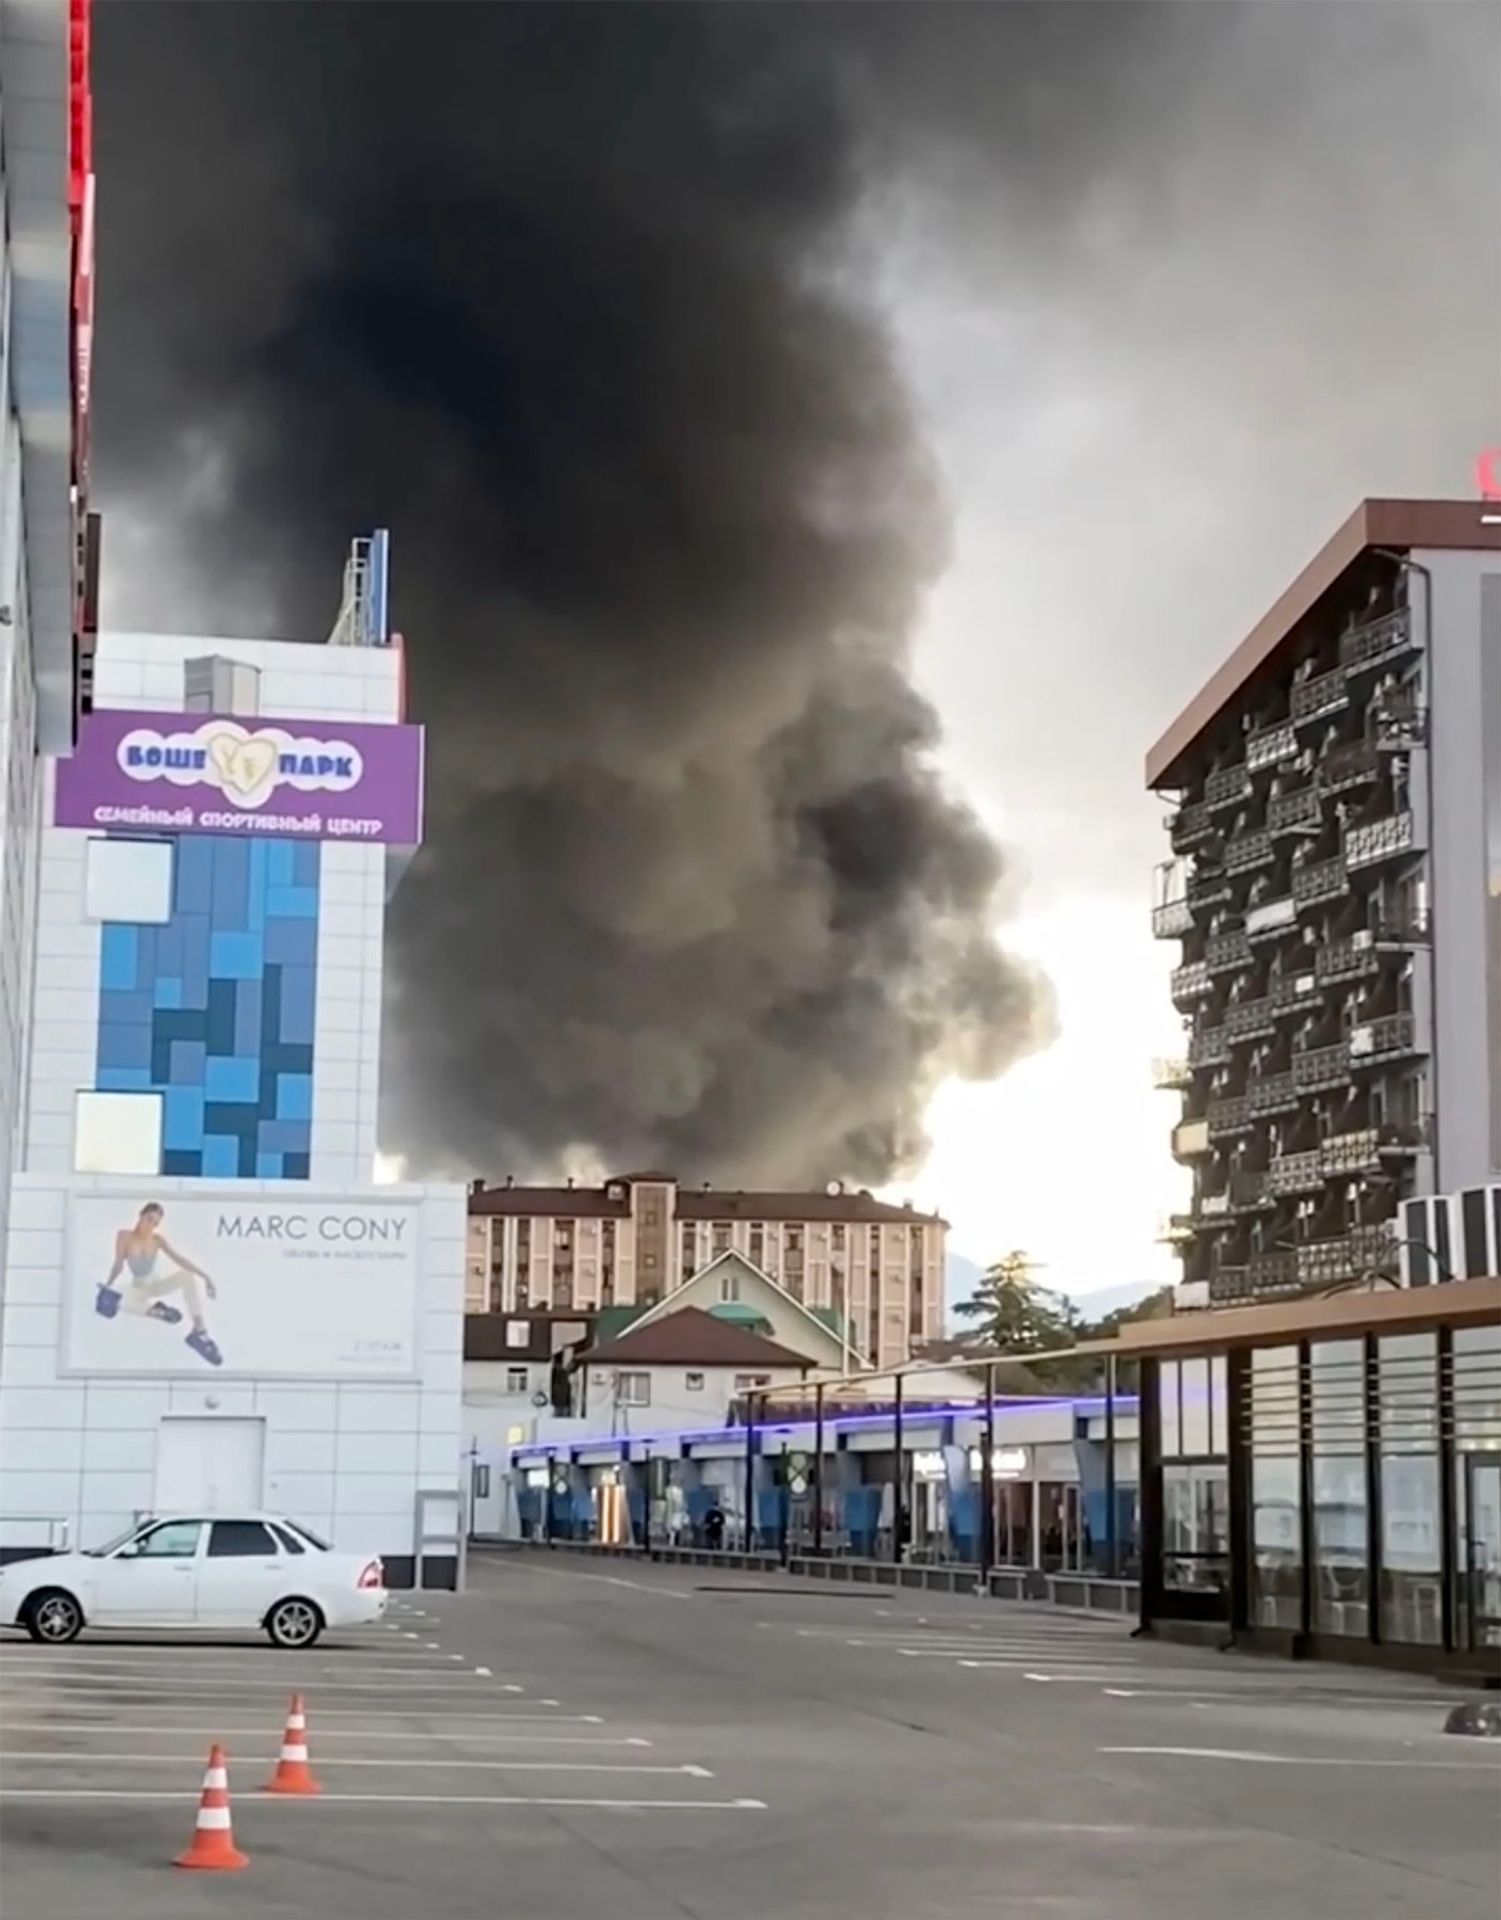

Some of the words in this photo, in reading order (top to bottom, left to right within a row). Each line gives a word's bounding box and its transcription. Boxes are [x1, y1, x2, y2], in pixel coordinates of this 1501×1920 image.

[279, 754, 353, 777] ПАРК
[94, 805, 193, 825] СЕМЕЙНЫЙ
[200, 810, 321, 831] СПОРТИВНЫЙ
[327, 818, 383, 836] ЦЕНТР
[216, 1214, 308, 1239] MARC
[318, 1215, 407, 1241] CONY
